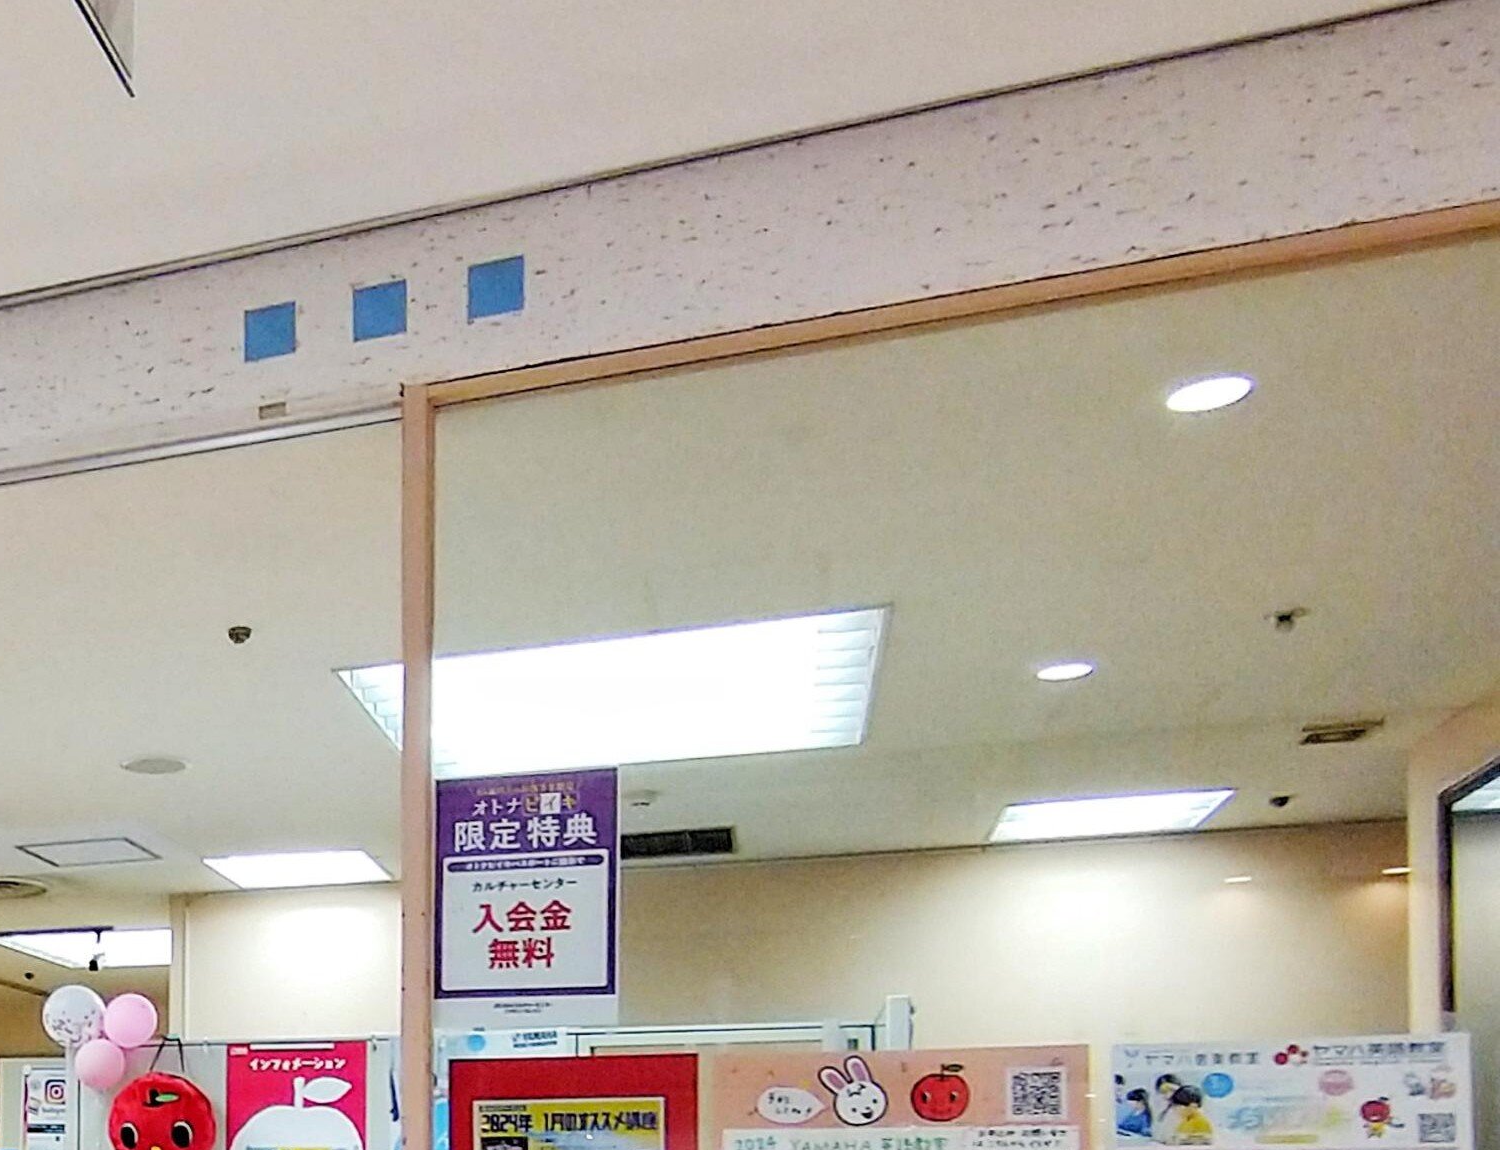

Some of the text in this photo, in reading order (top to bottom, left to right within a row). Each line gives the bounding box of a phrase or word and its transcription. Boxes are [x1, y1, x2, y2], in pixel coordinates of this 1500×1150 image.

[454, 812, 598, 852] 限定特典
[472, 879, 577, 892] カルチャーセンター
[472, 900, 572, 933] 入会金
[488, 937, 555, 969] 無料
[249, 1056, 347, 1072] インフォメーション
